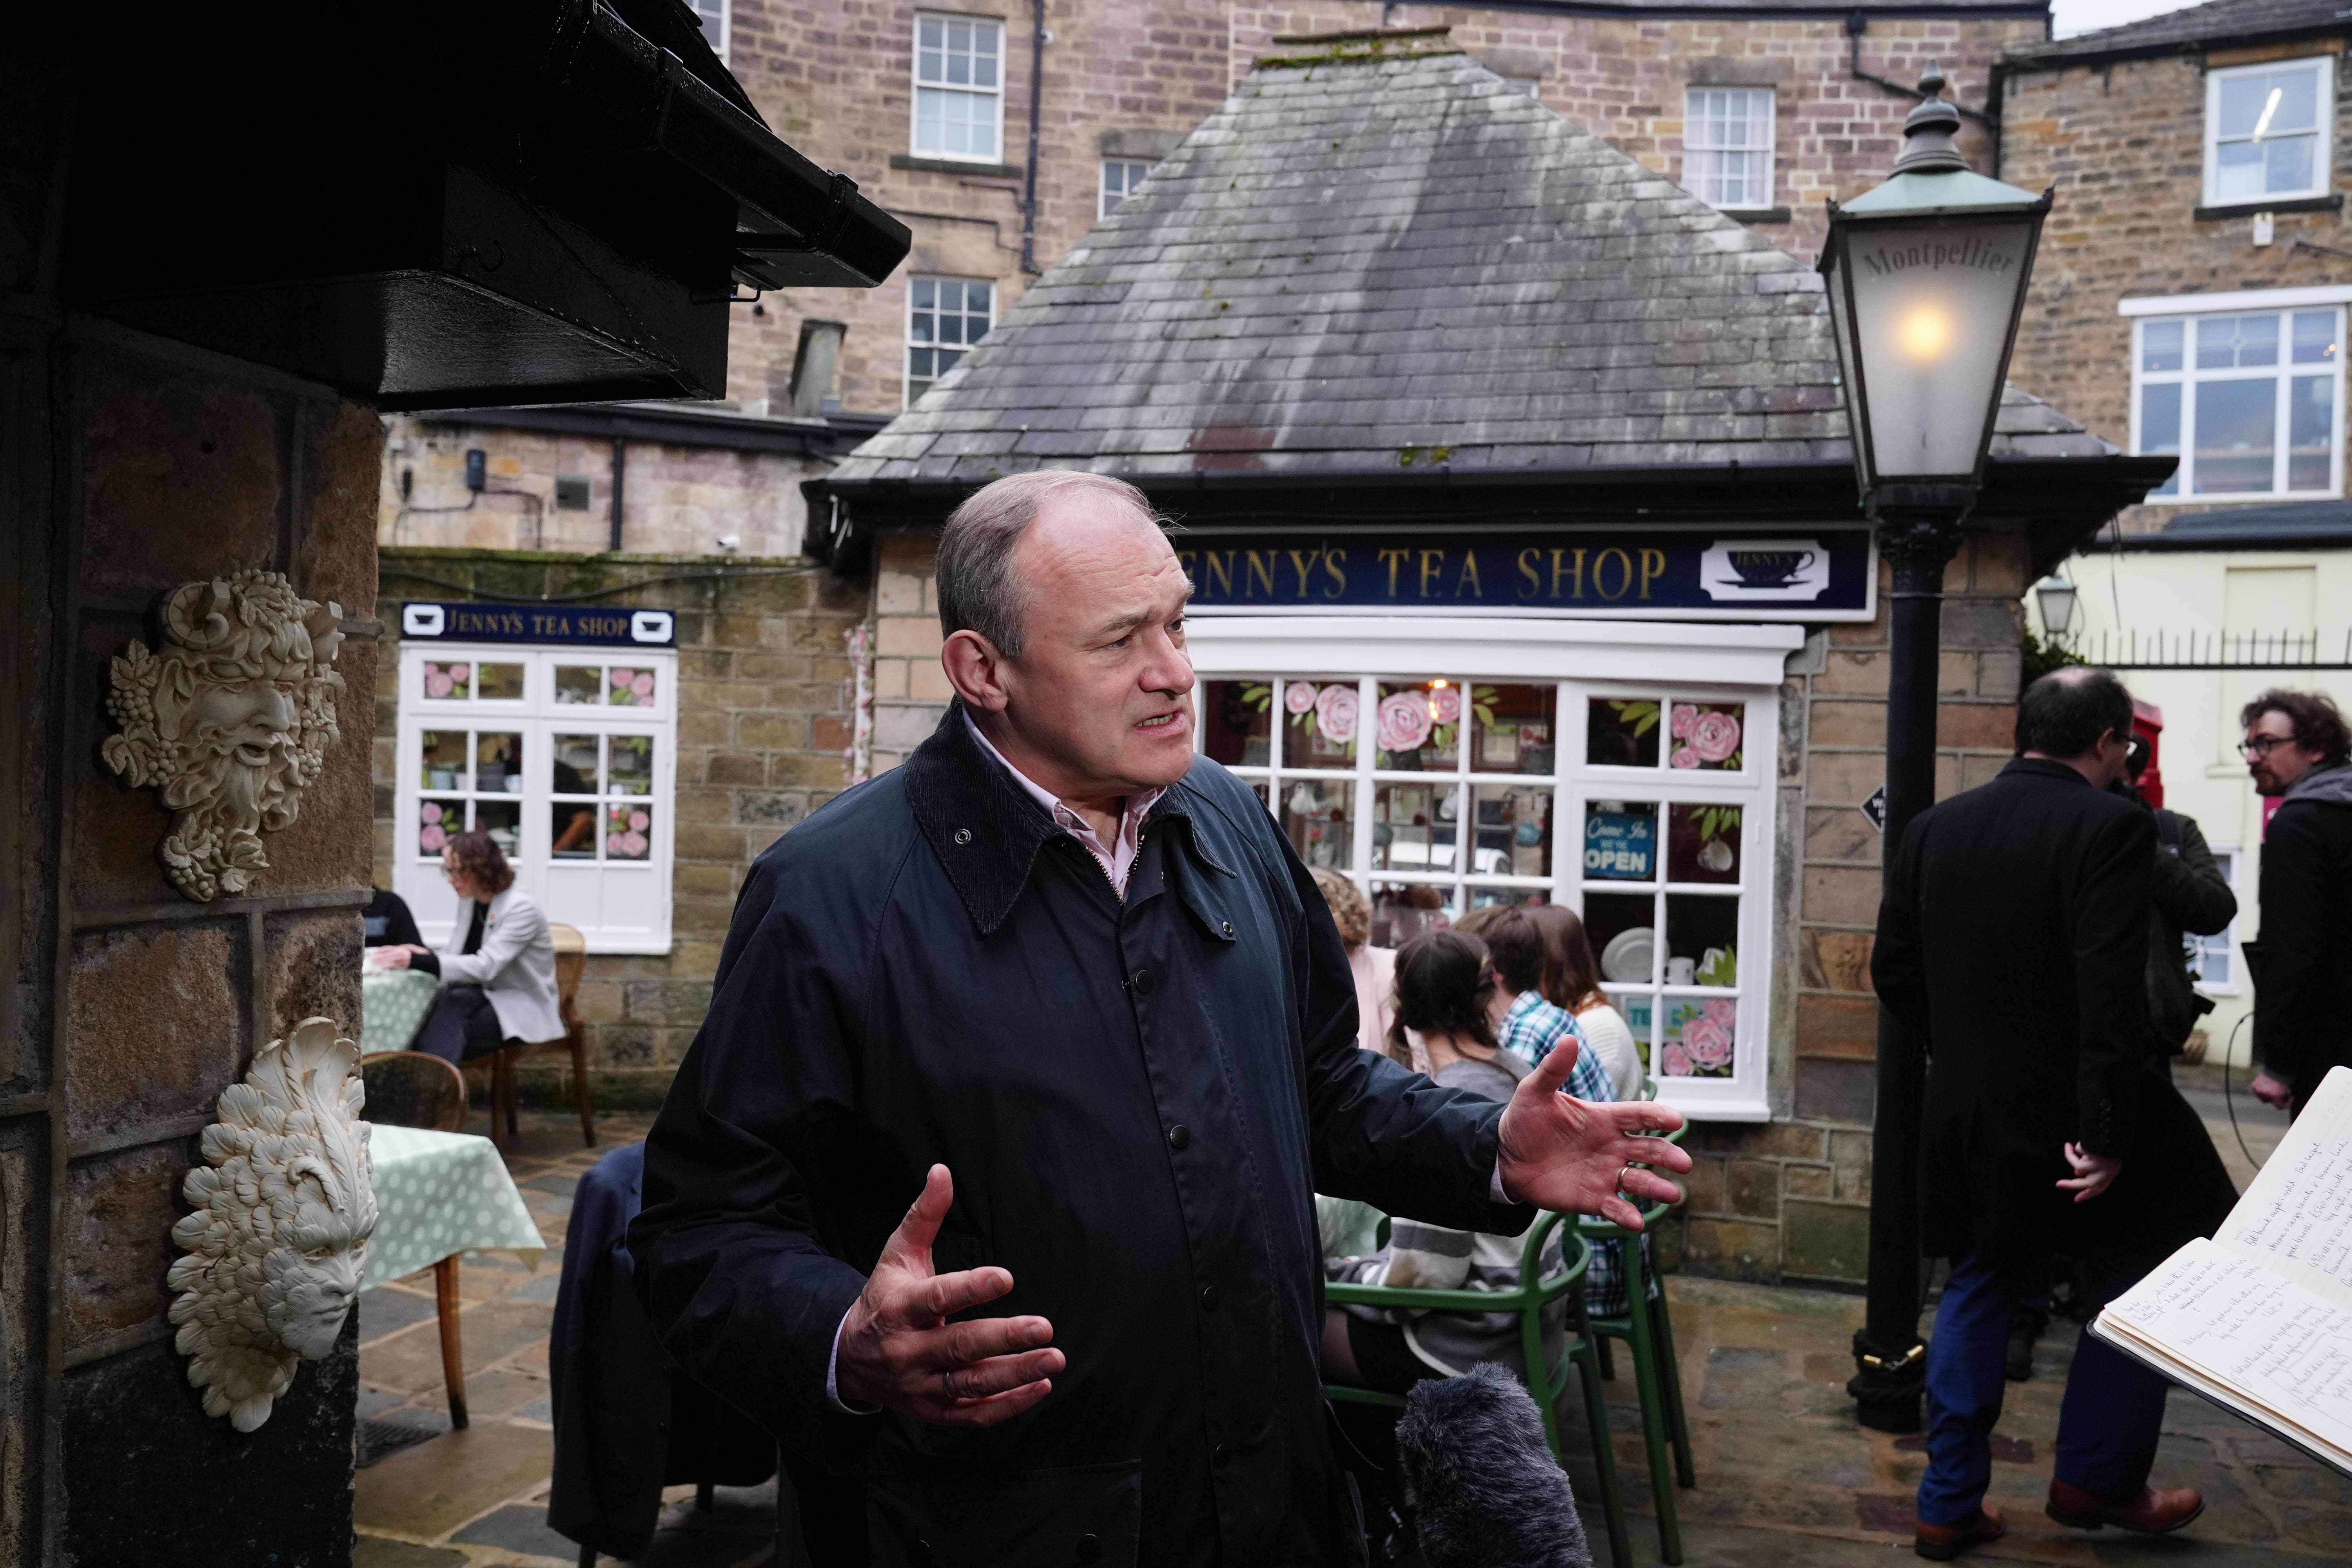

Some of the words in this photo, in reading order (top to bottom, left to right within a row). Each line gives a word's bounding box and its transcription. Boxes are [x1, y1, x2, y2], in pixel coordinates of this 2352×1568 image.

[1863, 237, 2014, 274] Montpellier
[1177, 541, 1347, 599] ENNY'S
[1377, 548, 1483, 597] TEA
[1516, 547, 1666, 601] SHOP
[449, 608, 523, 634] JENNY'S
[531, 614, 570, 635] TEA
[577, 616, 628, 637] SHOP
[1584, 849, 1647, 873] OPEN
